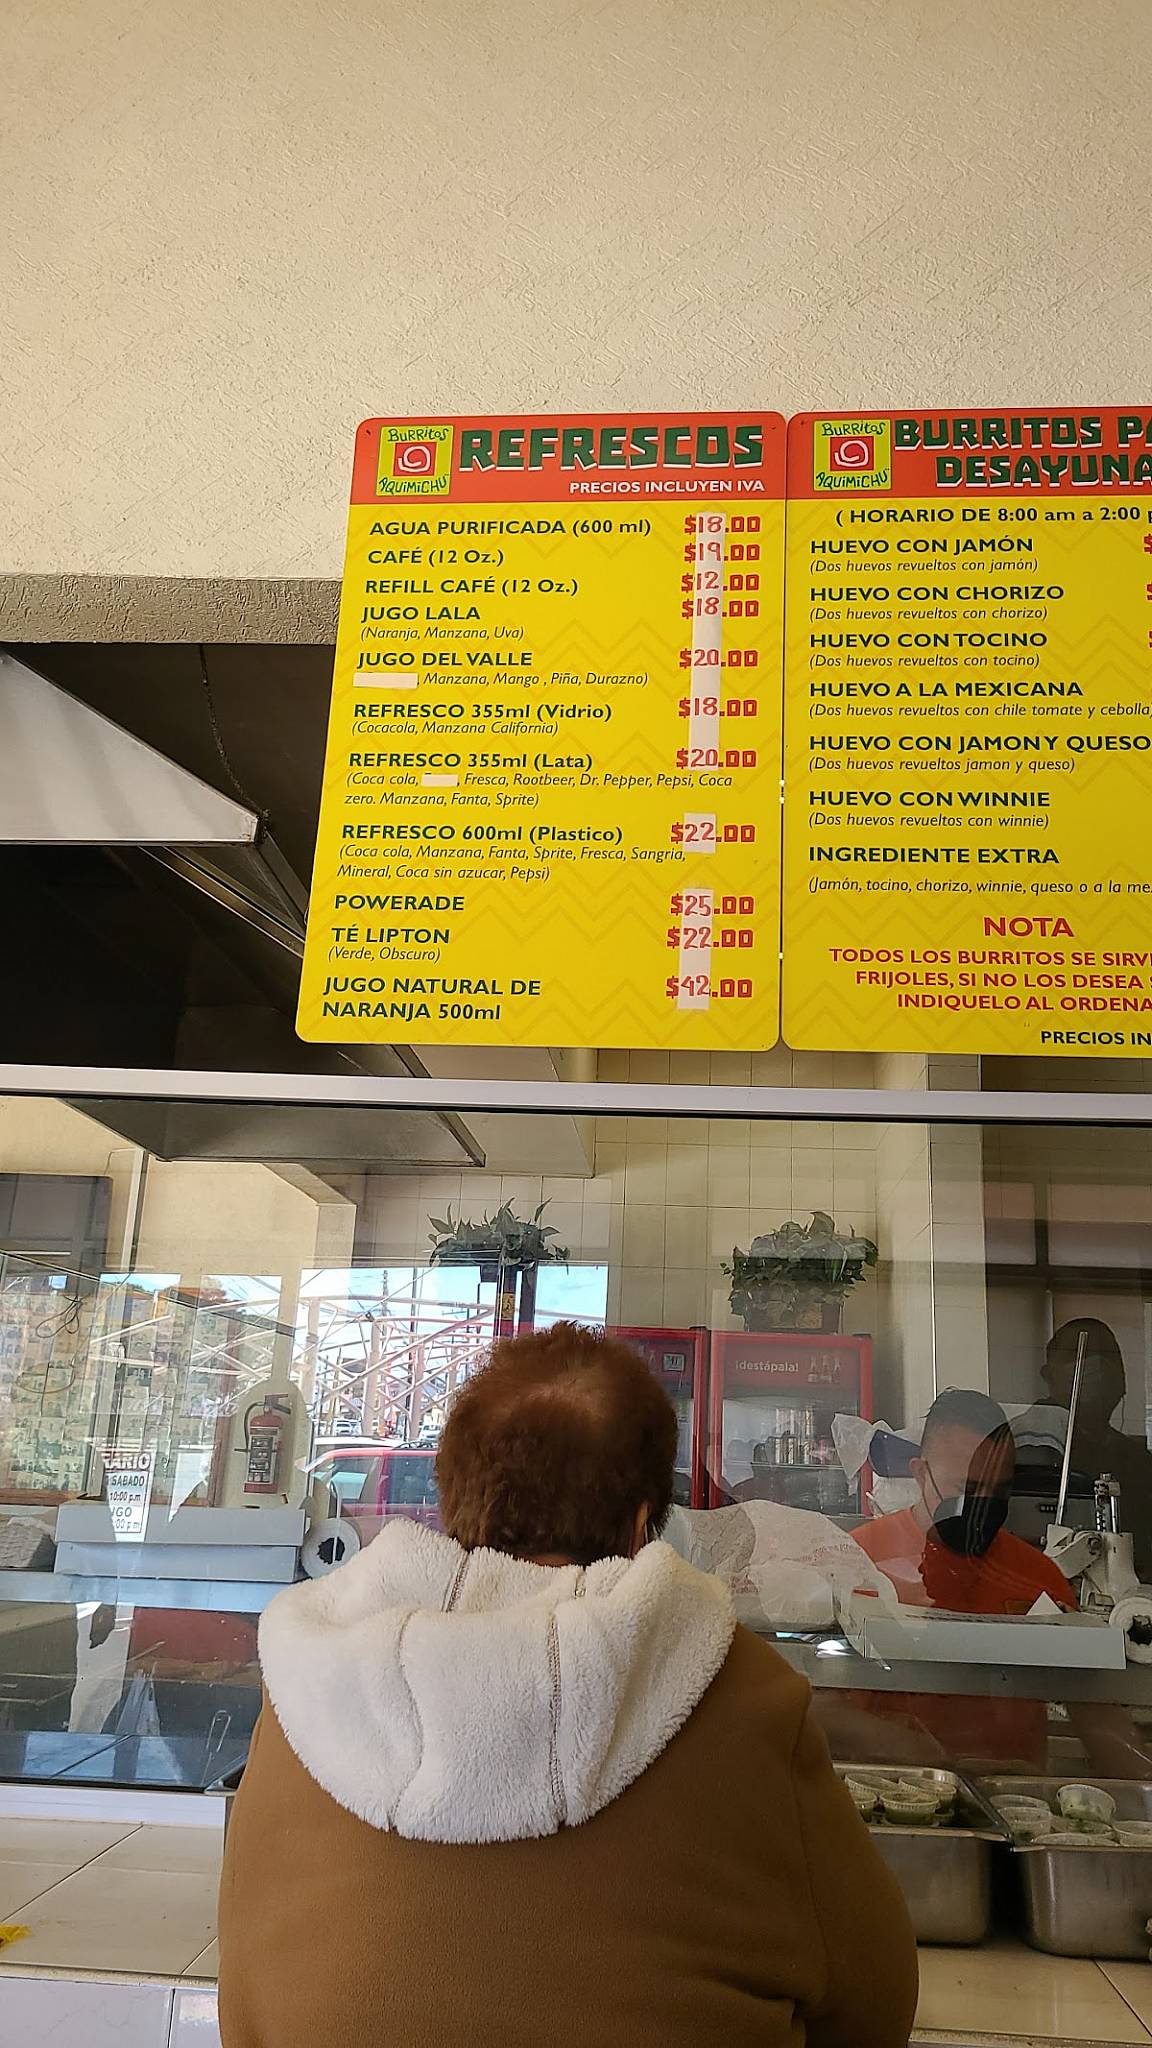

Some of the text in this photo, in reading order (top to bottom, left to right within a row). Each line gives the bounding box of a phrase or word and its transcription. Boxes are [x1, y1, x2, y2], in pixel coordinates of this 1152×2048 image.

[895, 417, 1102, 450] BURRITOS
[459, 426, 763, 471] REFRESCOS
[569, 480, 765, 494] PRECIOS INCLUYEN IVA
[851, 509, 954, 523] HORARIO
[962, 509, 990, 521] DE
[998, 508, 1037, 521] 8:00
[1045, 512, 1075, 521] am
[1083, 512, 1093, 520] a
[1100, 507, 1140, 520] 2:00
[369, 519, 650, 537] AGUA PURIFICADA (600 ml)
[684, 515, 761, 536] $18.00
[683, 543, 761, 565] $19.00
[811, 536, 1032, 555] HUEVO CON JAMÓN
[368, 547, 503, 567] CAFÉ (12 Oz.)
[366, 576, 577, 597] REFILL CAFÉ (12 Oz.)
[680, 572, 760, 593] $12.00
[811, 586, 1064, 601] HUEVO CON CHORIZO
[361, 607, 480, 623] JUGO LALA
[681, 600, 759, 621] $18.00
[361, 626, 523, 641] (Naranja, Manzana, Uva)
[811, 633, 1047, 647] HUEVO CON TOCINO
[357, 653, 532, 669] JUGO DEL VALLE
[679, 647, 758, 670] $20.00
[423, 673, 489, 686] Manzana,
[551, 673, 581, 686] Piña,
[586, 672, 647, 688] Durazno)
[811, 682, 1083, 697] HUEVO A LA MEXICANA
[354, 704, 611, 722] REFRESCO 355ml (Vidrio)
[677, 697, 758, 719] $18.00
[810, 704, 1082, 719] (Dos huevos revueltos con chile tomate
[352, 721, 558, 737] (Cocacola, Manzana California)
[810, 736, 1151, 754] HUEVO CON JAMON Y QUESO
[350, 753, 592, 772] REFRESCO 355ml (Lata)
[676, 748, 757, 769] $20.00
[347, 772, 384, 787] (Coca
[390, 772, 418, 786] cola,
[465, 773, 508, 787] Fresca,
[514, 773, 575, 787] Rootbeer,
[580, 774, 599, 785] Dr.
[604, 774, 652, 789] Pepper,
[657, 774, 693, 789] Pepsi,
[699, 774, 732, 786] Coca
[345, 792, 538, 808] zero. Manzana, Fanta, Sprite)
[810, 791, 1050, 806] HUEVO CON WINNIE
[342, 825, 622, 845] REFRESCO 600ml (Plastico)
[670, 822, 755, 843] $22.00
[340, 844, 685, 863] (Coca cola, Manzana, Fanta, Sprite, Fresca, Sangria,
[810, 847, 1059, 863] INGREDIENTE EXTRA
[337, 864, 549, 882] Mineral, Coca sin azucar, Pepsi)
[809, 877, 1073, 896] (Jamón, tocino, chorizo, winnie, queso
[335, 895, 464, 910] POWERADE
[670, 895, 755, 917] $25.00
[331, 924, 449, 943] TÉ LIPTON
[984, 917, 1074, 937] NOTA
[666, 926, 754, 950] $22.00
[329, 946, 440, 964] (Verde, Obscuro)
[829, 949, 1096, 965] TODOS LOS BURRITOS SE
[323, 977, 540, 995] JUGO NATURAL DE
[665, 974, 753, 998] $42.00
[857, 971, 954, 988] FRIJOLES,
[959, 973, 976, 986] SI
[984, 973, 1017, 986] NO
[1024, 974, 1066, 987] LOS
[1073, 975, 1144, 989] DESEA
[898, 994, 1020, 1011] INDIQUELO
[1025, 996, 1054, 1010] AL
[323, 1002, 500, 1022] NARANJA 500ml
[1041, 1031, 1124, 1044] PRECIOS
[735, 1360, 799, 1373] ¡destápala!
